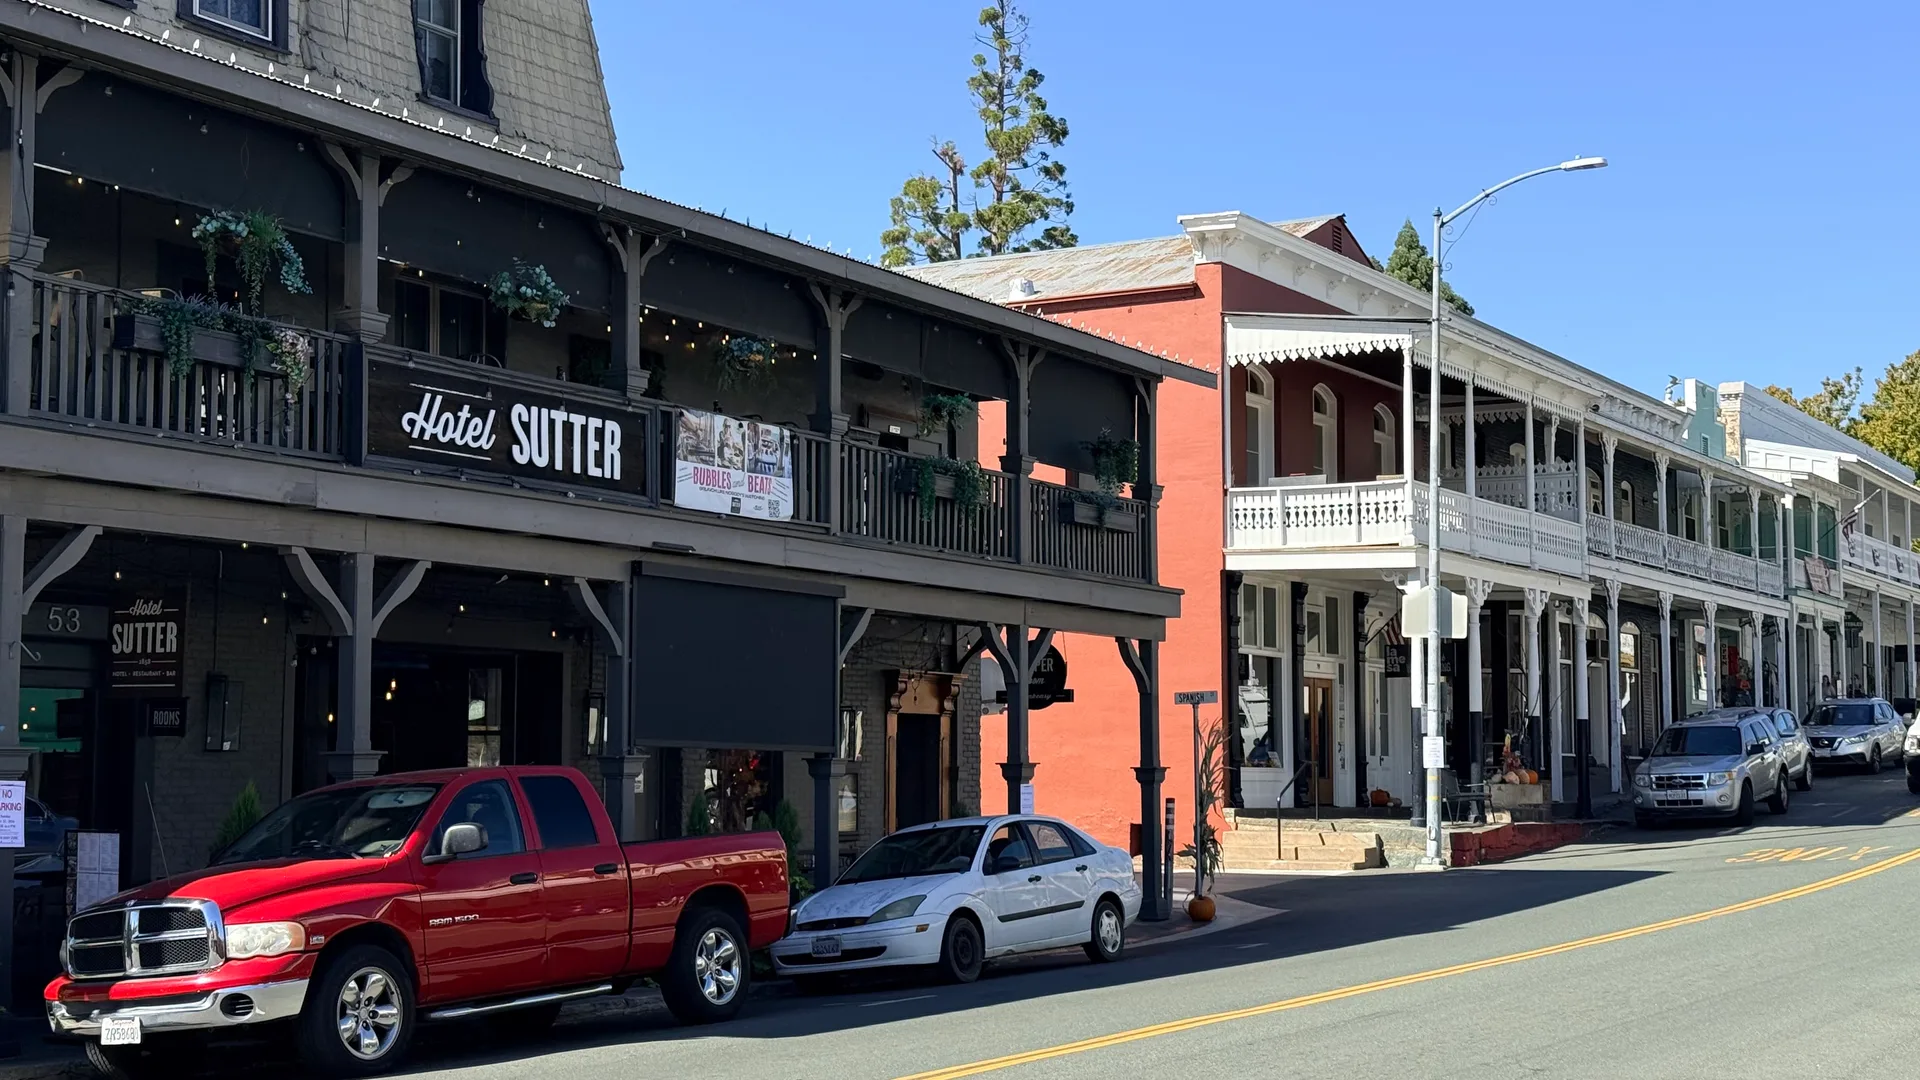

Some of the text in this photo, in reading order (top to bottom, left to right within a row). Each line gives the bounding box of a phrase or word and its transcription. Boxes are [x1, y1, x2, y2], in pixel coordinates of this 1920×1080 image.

[401, 392, 622, 481] Hotel SUTTER
[693, 466, 732, 490] BUBBLES
[747, 474, 772, 495] BEATS
[129, 599, 162, 616] Hotel
[48, 606, 81, 633] 53
[112, 622, 177, 654] SUTTER
[1386, 646, 1397, 657] la
[1034, 658, 1054, 672] PER
[1386, 655, 1406, 664] me
[1386, 664, 1401, 672] sa
[1178, 692, 1205, 703] SPANISH
[153, 710, 180, 725] ROOMS
[2, 789, 13, 799] NO
[0, 802, 22, 811] RKING
[429, 914, 479, 927] RAM 1500
